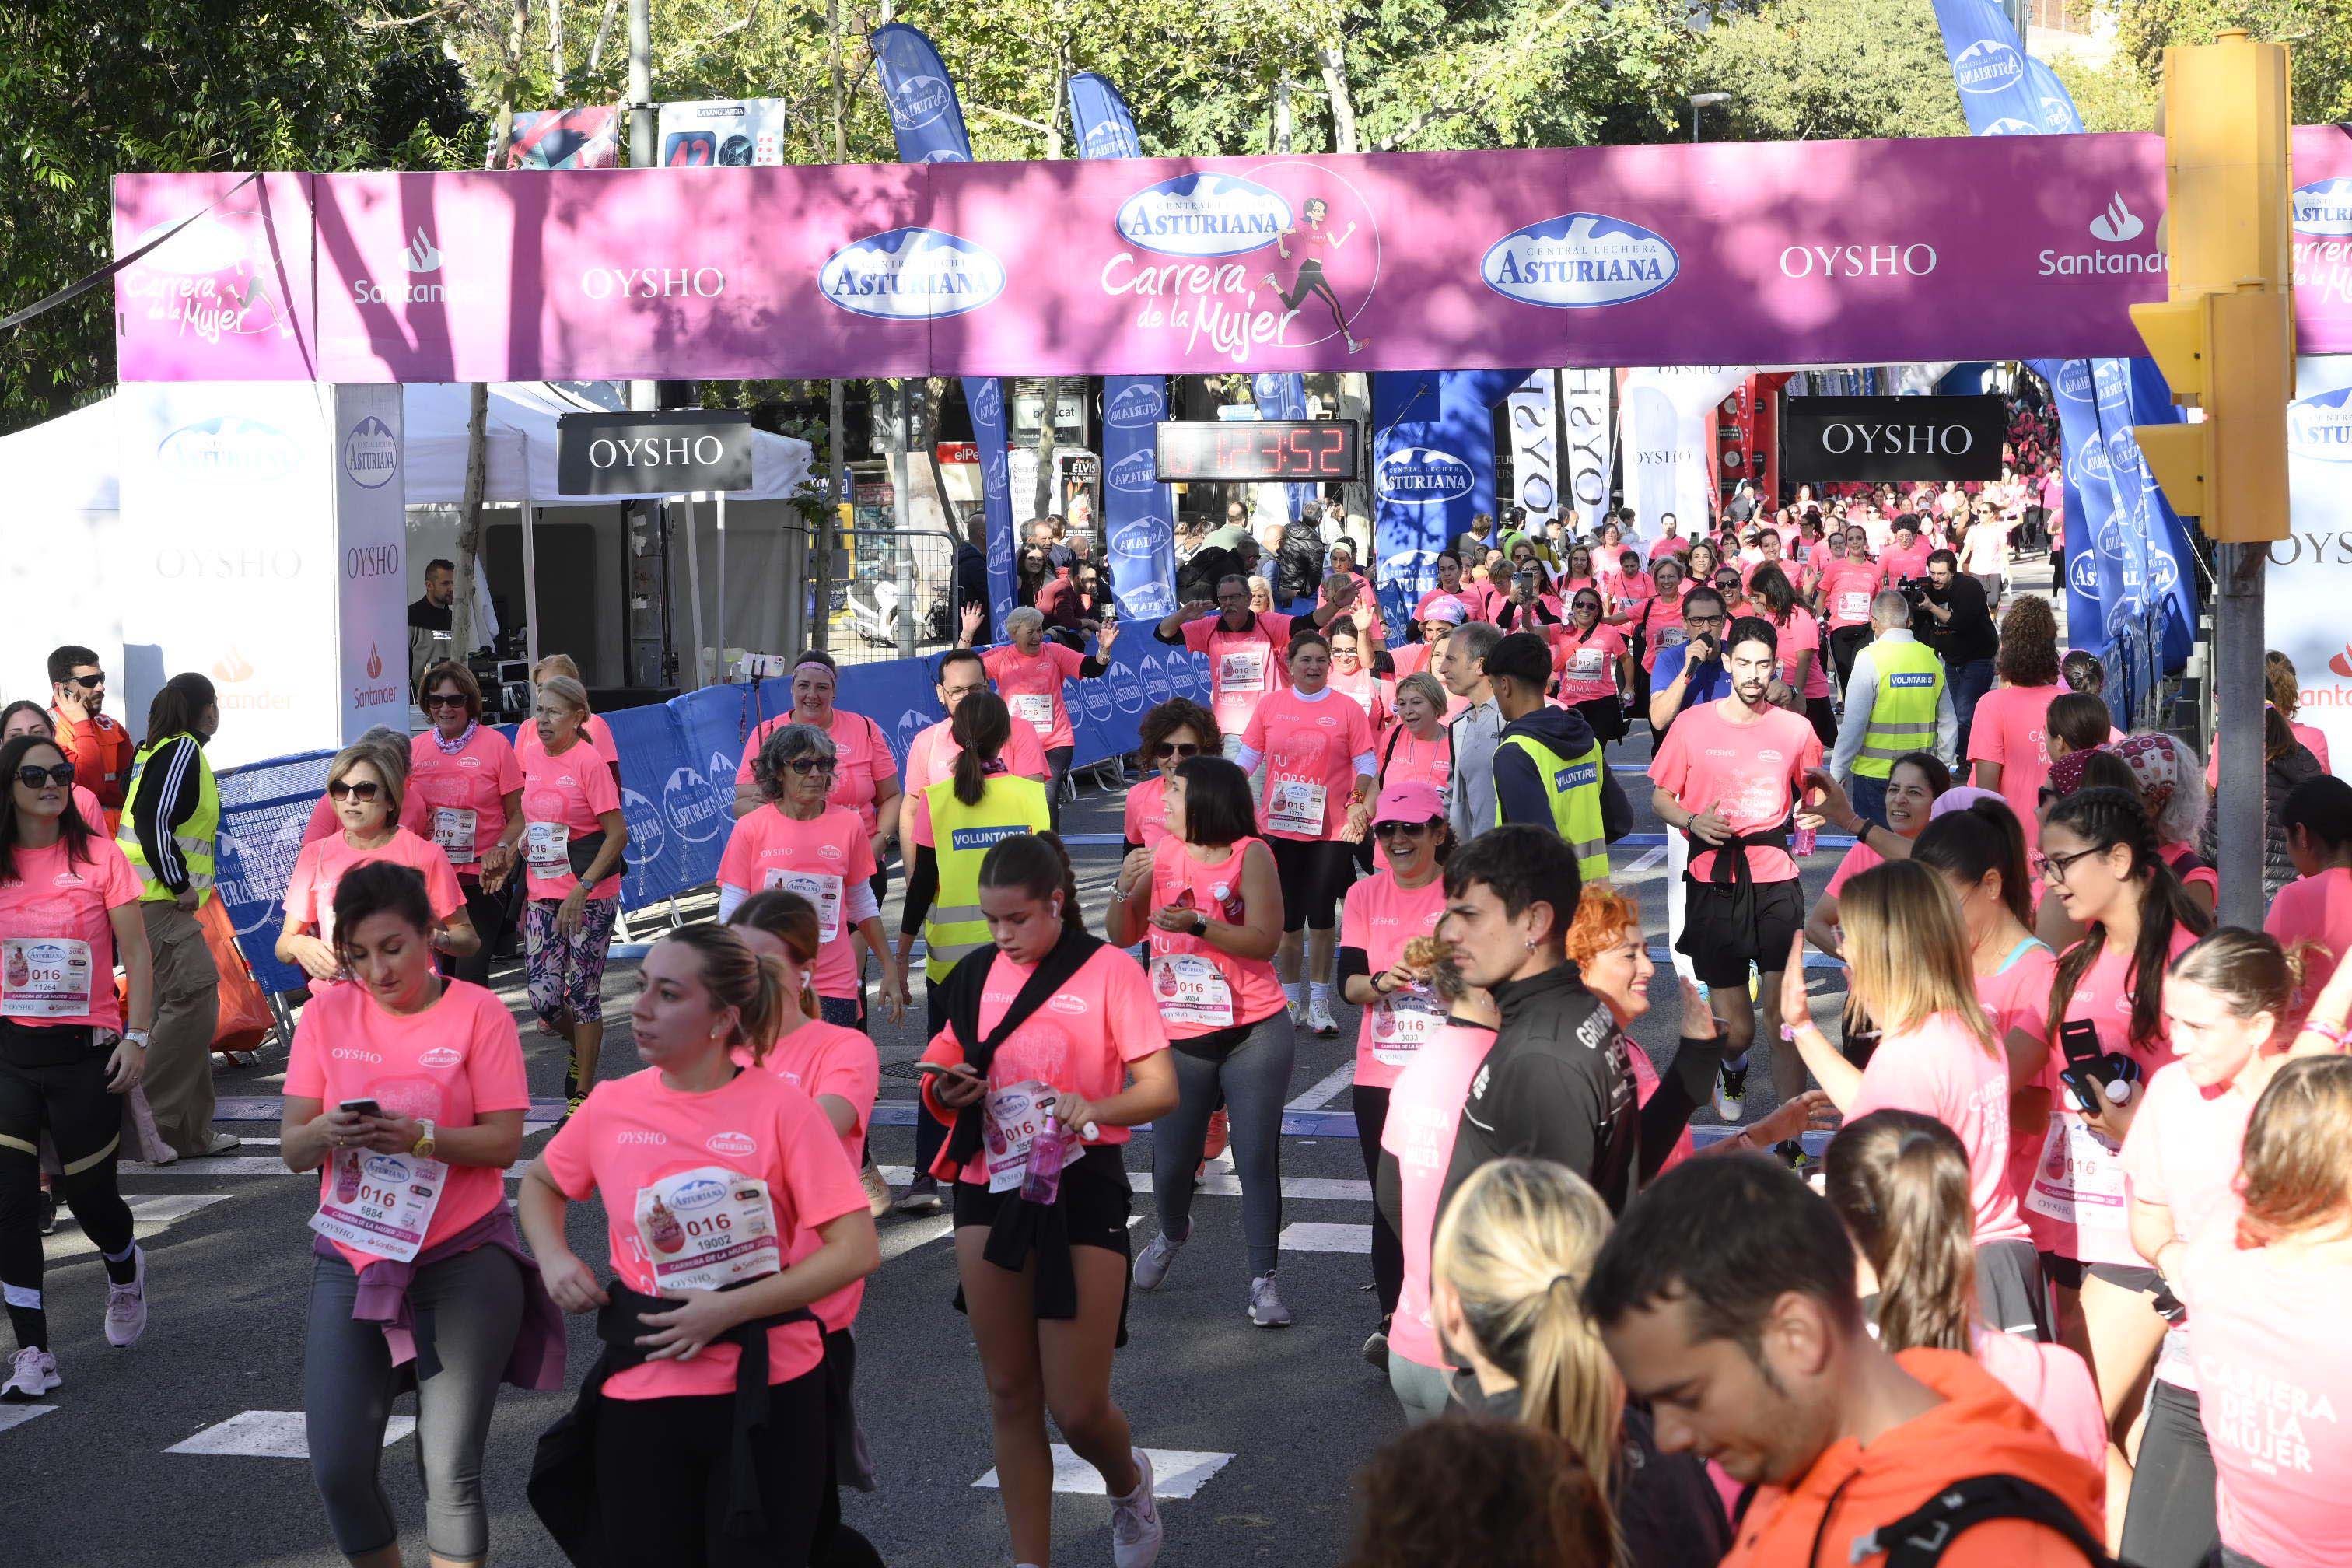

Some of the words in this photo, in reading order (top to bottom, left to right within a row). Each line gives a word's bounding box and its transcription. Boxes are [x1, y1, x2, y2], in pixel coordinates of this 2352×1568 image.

[1129, 205, 1279, 236] ASTURIANA
[1527, 247, 1587, 256] CENTRAL
[1594, 244, 1658, 254] LECHERA
[1496, 250, 1664, 284] ASTURIANA
[1780, 243, 1937, 278] OYSHO
[581, 267, 725, 299] OYSHO
[832, 263, 990, 296] ASTURIANA
[1101, 253, 1247, 296] Carrera
[1137, 298, 1164, 328] de
[1170, 297, 1189, 327] la
[1185, 289, 1301, 363] Mujer
[1033, 407, 1075, 418] b.cat
[1822, 424, 1972, 455] OYSHO
[348, 443, 395, 471] ASTURIANA
[589, 436, 723, 468] OYSHO
[1072, 463, 1096, 473] ELVIS
[1380, 470, 1467, 491] ASTURIANA
[347, 544, 398, 579] OYSHO
[1395, 577, 1439, 592] TURI
[354, 684, 397, 710] Santander
[1566, 683, 1591, 693] SUMA
[1218, 692, 1244, 704] SUMA
[1272, 754, 1287, 767] TU
[1287, 801, 1305, 810] 016
[436, 829, 453, 838] 016
[954, 831, 1026, 845] VOLUNTA
[530, 845, 547, 853] 016
[761, 848, 793, 858] OYSHO
[789, 883, 818, 892] ASTURIANA
[1151, 933, 1170, 954] TU
[31, 969, 61, 981] 016
[1176, 964, 1206, 973] ASTURIANA
[1179, 982, 1204, 993] 016
[1398, 1019, 1424, 1031] 016
[331, 1047, 383, 1065] OYSHO
[617, 1130, 667, 1146] OYSHO
[1005, 1121, 1034, 1142] 016
[2067, 1157, 2098, 1175] 016
[361, 1185, 397, 1208] 016
[674, 1188, 723, 1207] ASTURIANA
[361, 1205, 383, 1220] 6884
[2038, 1199, 2071, 1215] OYSHO
[365, 1220, 375, 1229] LA
[375, 1223, 397, 1235] MUJER
[686, 1213, 732, 1237] 016
[320, 1220, 355, 1240] OYSHO
[374, 1239, 408, 1255] Santander
[697, 1234, 733, 1251] 19002
[669, 1257, 706, 1272] CARRERA
[706, 1254, 716, 1264] DE
[716, 1251, 727, 1260] LA
[670, 1272, 712, 1288] OYSHO
[2198, 1355, 2337, 1423] CARRERA
[2221, 1390, 2257, 1429] DE
[2266, 1406, 2306, 1444] LA
[2218, 1414, 2313, 1474] MUJER
